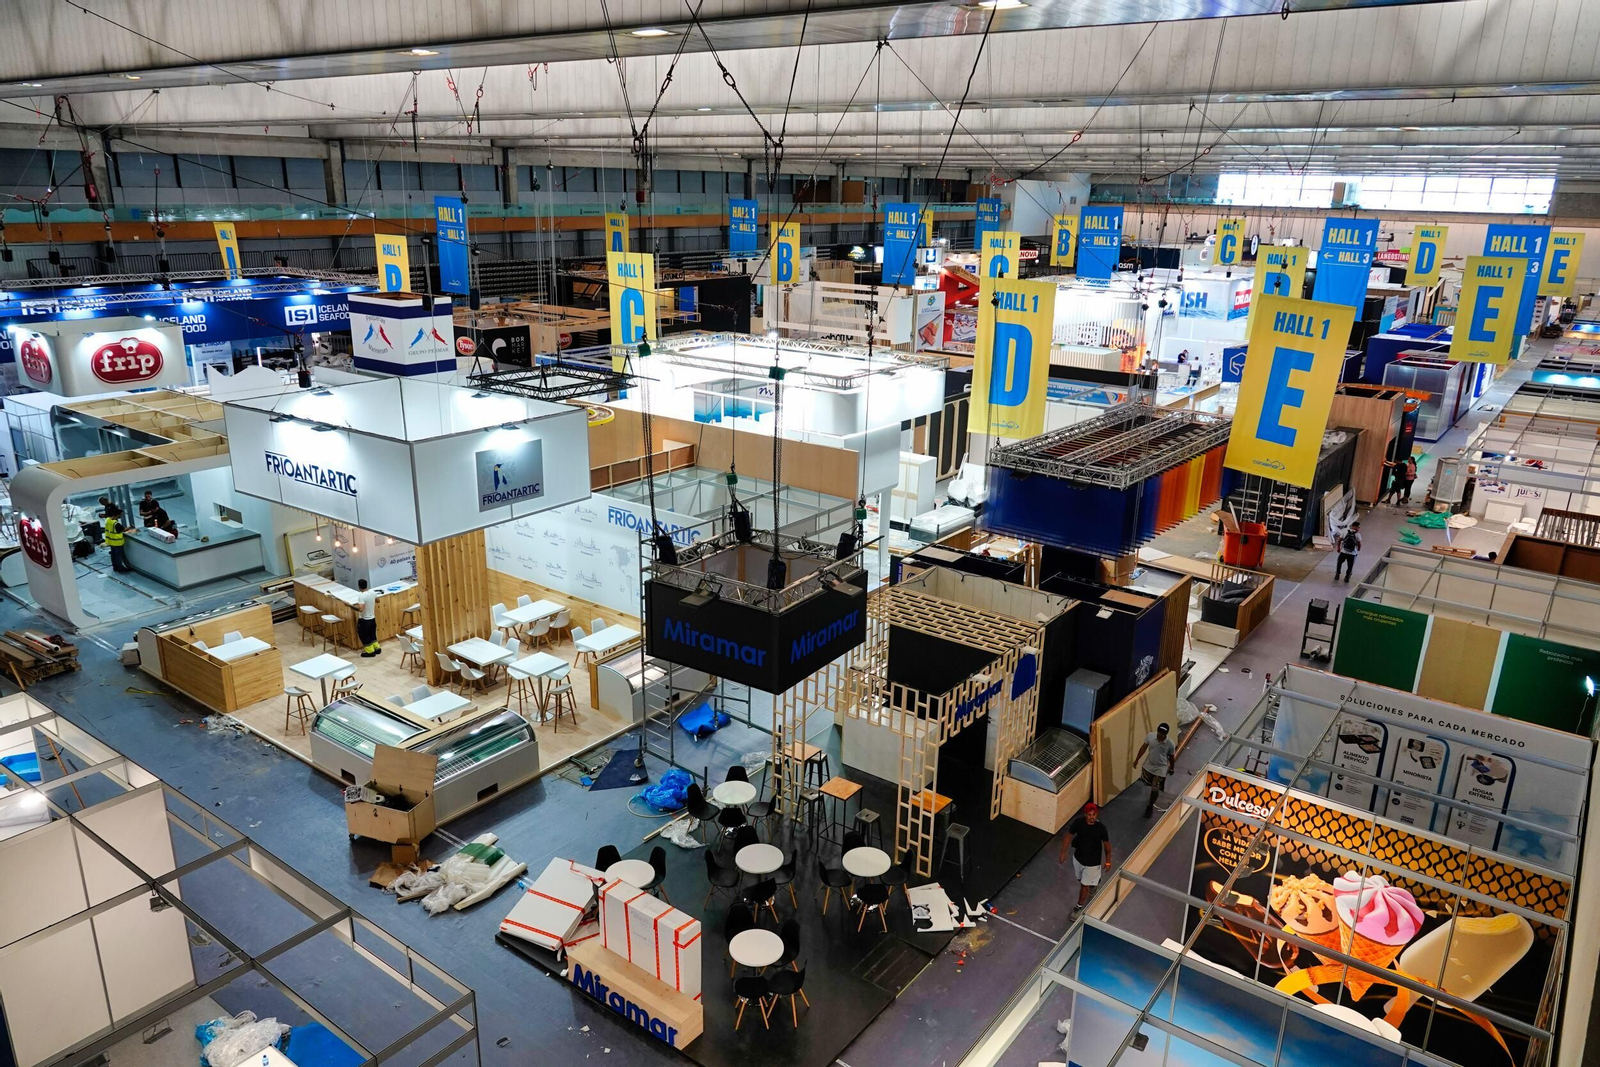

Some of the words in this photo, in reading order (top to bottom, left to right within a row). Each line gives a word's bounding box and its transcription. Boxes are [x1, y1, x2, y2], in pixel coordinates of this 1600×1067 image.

[438, 206, 457, 223] HALL
[458, 208, 463, 223] 1
[732, 206, 749, 219] HALL
[751, 208, 755, 219] 1
[979, 203, 993, 212] HALL
[995, 204, 999, 212] 1
[610, 218, 621, 227] HALL
[888, 211, 909, 225] HALL
[911, 213, 916, 226] 1
[1084, 215, 1109, 230] HALL
[1113, 216, 1119, 230] 1
[739, 223, 751, 232] HALL
[752, 224, 756, 233] 3
[778, 228, 790, 237] HALL
[791, 229, 794, 237] 1
[1223, 223, 1235, 231] HALL
[1420, 230, 1436, 238] HALL
[1437, 230, 1441, 238] 1
[219, 229, 230, 241] HALL
[447, 229, 460, 240] HALL
[460, 230, 465, 241] 3
[896, 230, 910, 239] HALL
[911, 231, 916, 240] 3
[1057, 229, 1071, 256] B
[1093, 236, 1111, 245] HALL
[1112, 236, 1119, 246] 3
[1328, 227, 1360, 245] HALL
[1365, 229, 1373, 246] 1
[1554, 237, 1571, 245] HALL
[1573, 237, 1577, 245] 1
[382, 243, 397, 257] HALL
[397, 245, 401, 257] 1
[990, 238, 1006, 248] HALL
[1008, 239, 1012, 249] 1
[1220, 234, 1237, 264] C
[1490, 235, 1527, 253] HALL
[1533, 237, 1543, 254] 1
[777, 242, 793, 282] B
[1019, 251, 1038, 260] NOVA
[1267, 253, 1286, 266] HALL
[1292, 254, 1297, 266] 1
[1338, 251, 1360, 263] HALL
[1362, 252, 1370, 264] 3
[1415, 241, 1437, 275] D
[617, 262, 638, 278] HALL
[639, 264, 644, 279] 1
[1477, 265, 1504, 278] HALL
[1507, 266, 1514, 279] 1
[1530, 261, 1540, 274] 3
[1547, 249, 1571, 284] E
[385, 263, 403, 293] D
[995, 291, 1028, 312] HALL
[1032, 295, 1039, 313] 1
[1180, 291, 1208, 309] ISH
[288, 308, 315, 323] ISI
[318, 303, 349, 314] ICELAN
[620, 287, 645, 345] C
[1468, 285, 1505, 343] E
[319, 311, 350, 322] SEAFOO
[182, 323, 207, 333] FOOD
[1273, 311, 1314, 338] HALL
[1321, 318, 1331, 340] 1
[24, 347, 48, 379] frip
[99, 349, 155, 376] frip
[989, 321, 1033, 407] D
[1255, 346, 1315, 448] E
[1252, 459, 1280, 470] conxemar
[265, 452, 358, 495] FRIOANTARTIC
[482, 483, 541, 507] FRIOANTARTIC
[23, 524, 49, 563] frip
[663, 616, 767, 667] Miramar
[790, 608, 859, 664] Miramar
[1539, 648, 1570, 660] Rebozados
[1340, 694, 1404, 717] SOLUCIONES
[1408, 712, 1434, 725] PARA
[1438, 719, 1467, 733] CADA
[1471, 728, 1526, 748] MERCADO
[1343, 750, 1369, 762] ALIMENTO
[1343, 754, 1368, 766] SERVICIO
[1403, 769, 1433, 782] MINORISTA
[1468, 790, 1496, 802] ENTREGA
[1472, 786, 1494, 797] HOGAR
[1222, 833, 1232, 842] LA
[1233, 836, 1250, 848] VIDA
[1212, 838, 1232, 850] SABE
[1233, 843, 1262, 861] MEOR
[1219, 848, 1237, 860] CON
[573, 963, 678, 1046] Miramar
